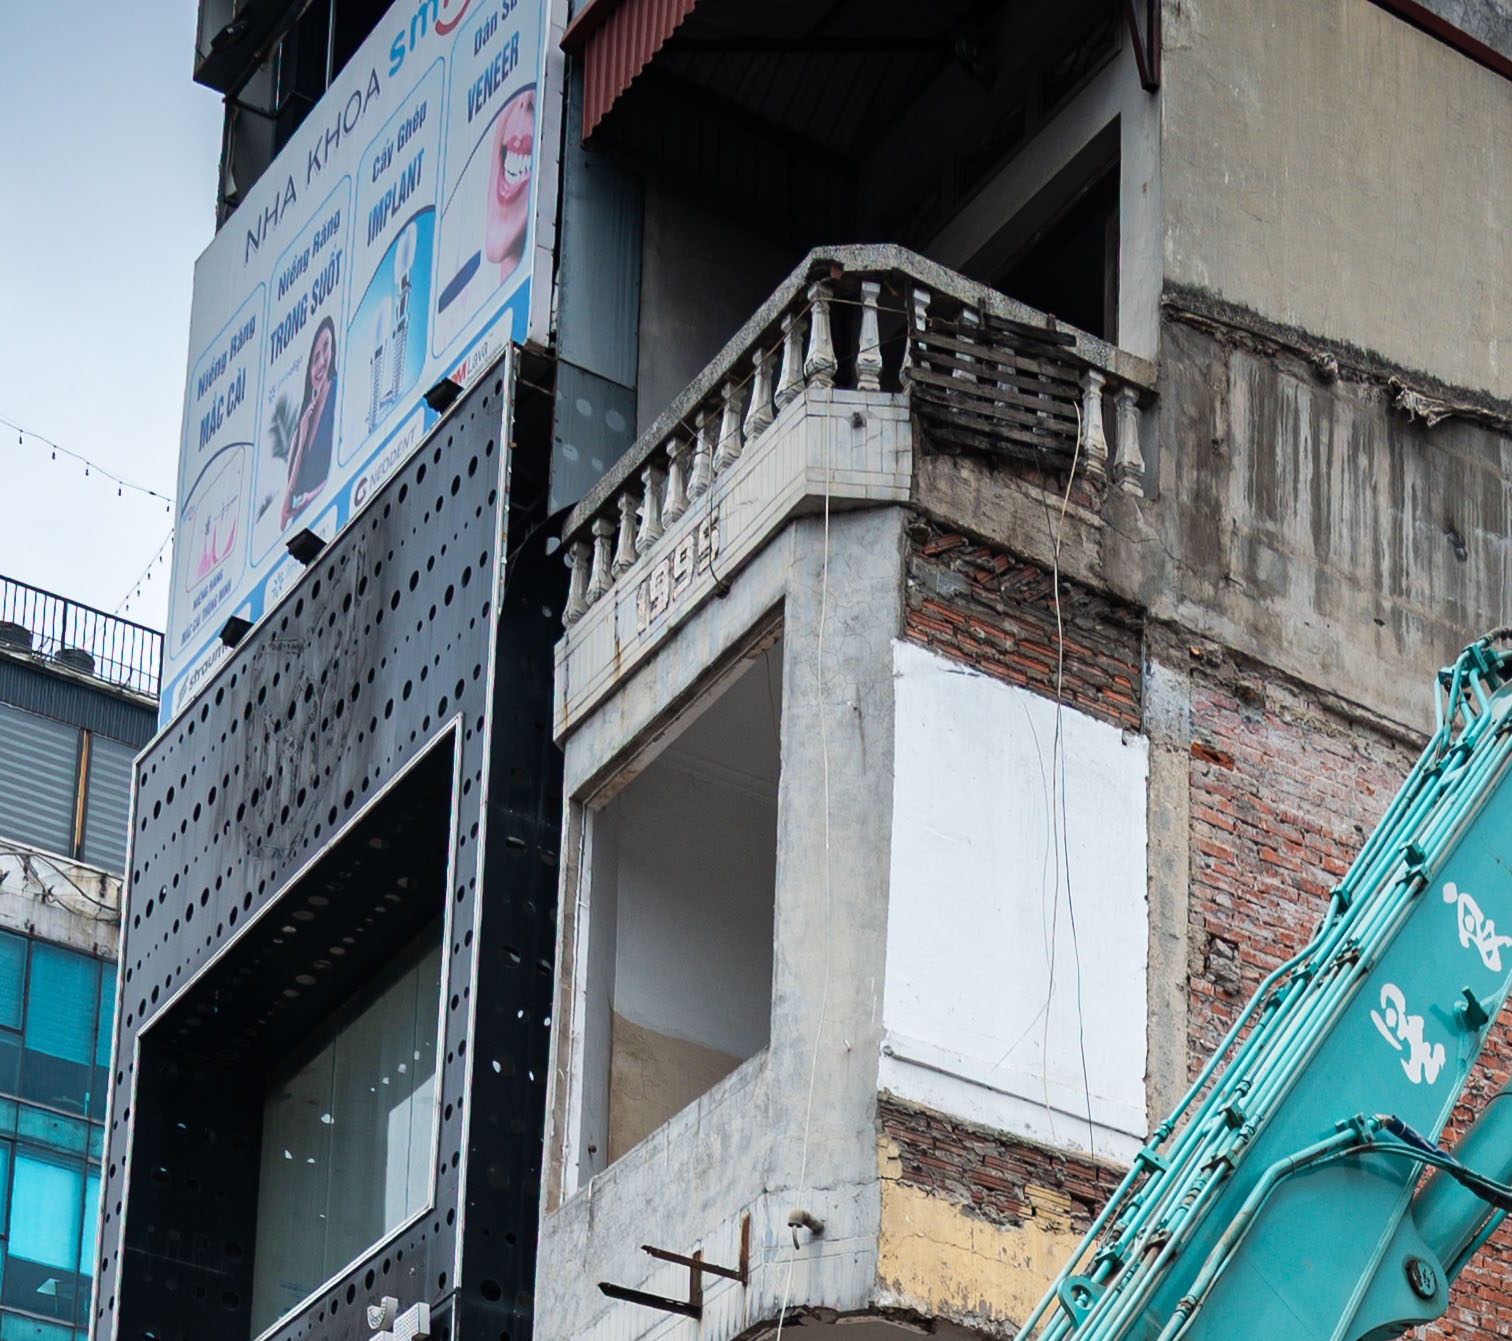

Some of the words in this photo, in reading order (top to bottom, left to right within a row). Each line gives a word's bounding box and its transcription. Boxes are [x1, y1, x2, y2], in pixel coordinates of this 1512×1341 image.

[467, 30, 519, 123] VENEER
[245, 175, 297, 265] NHA
[307, 68, 380, 185] KHOA
[397, 101, 427, 153] Ghép
[367, 147, 425, 247] IMPLANT
[271, 298, 308, 366] TRONG
